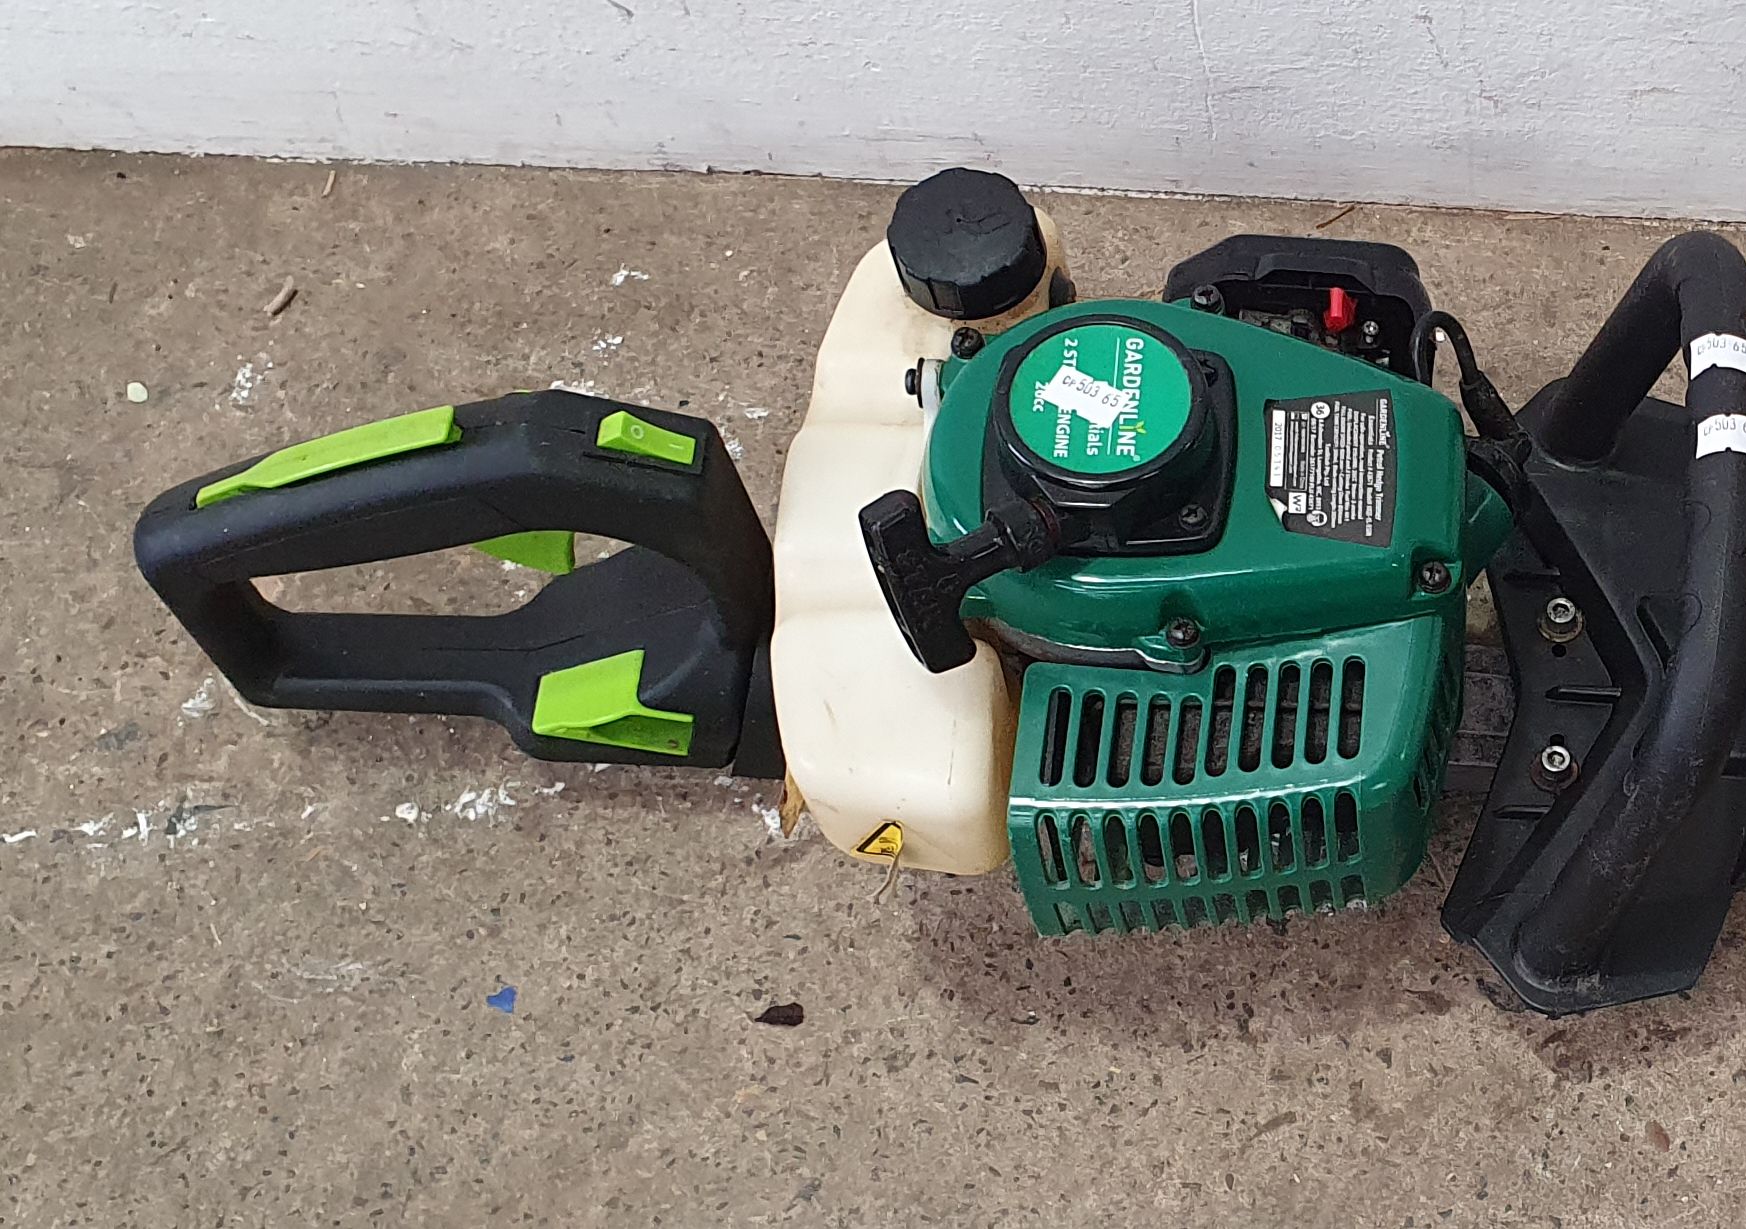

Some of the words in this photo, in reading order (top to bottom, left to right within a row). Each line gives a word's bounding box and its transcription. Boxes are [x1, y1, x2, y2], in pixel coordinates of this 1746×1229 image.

[1064, 338, 1078, 347] 2
[1101, 393, 1121, 408] 65
[1316, 404, 1325, 415] 36
[1053, 409, 1071, 457] ENGINE
[1274, 422, 1282, 440] 2017
